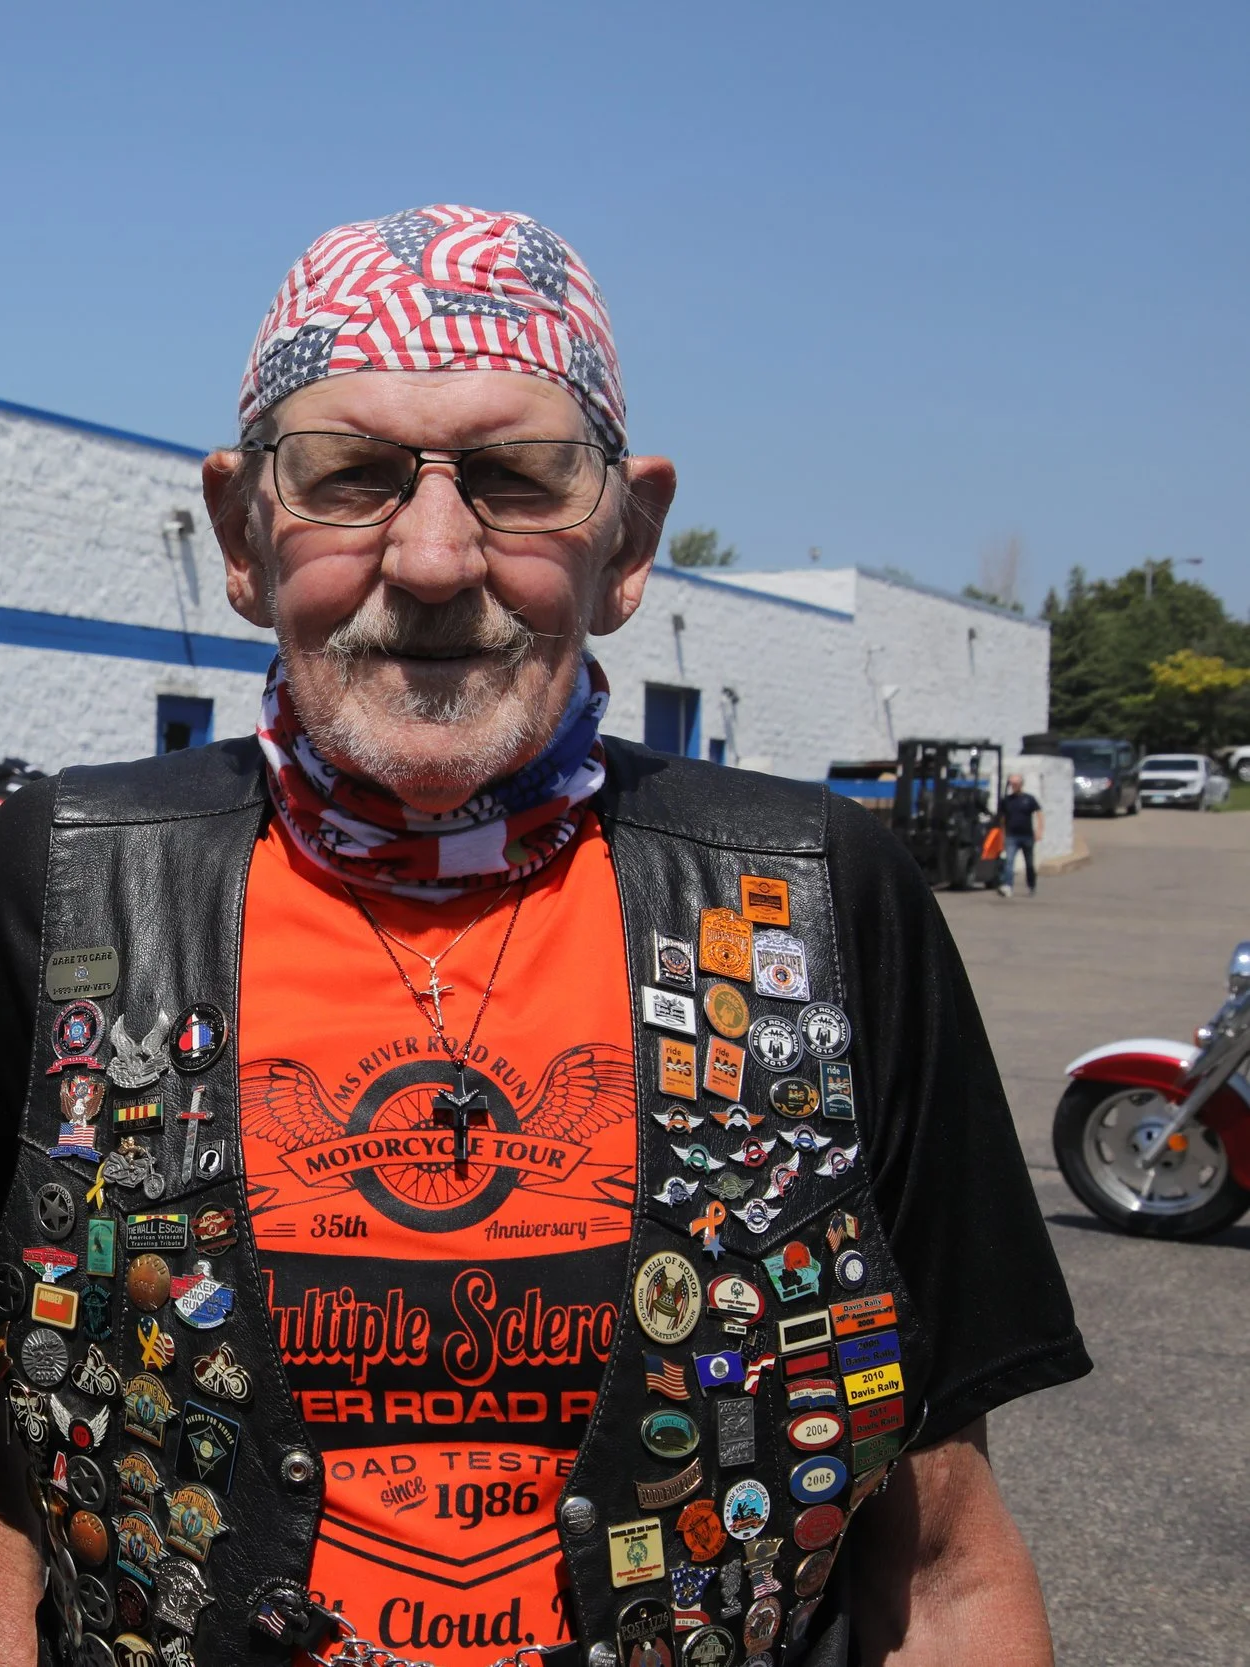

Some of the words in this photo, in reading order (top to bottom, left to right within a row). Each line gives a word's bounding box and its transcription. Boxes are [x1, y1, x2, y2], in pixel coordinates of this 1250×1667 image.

[52, 956, 76, 966] DARE
[77, 955, 88, 963] TO
[89, 951, 113, 962] CARE
[802, 1009, 817, 1033] RIVER
[818, 1007, 841, 1020] ROAD
[839, 1022, 847, 1041] RUN
[753, 1022, 767, 1046] RIVER
[768, 1020, 792, 1032] ROAD
[791, 1033, 799, 1053] RUN
[666, 1046, 682, 1056] ride
[715, 1047, 730, 1057] ride
[333, 1072, 362, 1104] MS
[357, 1036, 420, 1076] RIVER
[427, 1034, 489, 1064] ROAD
[490, 1056, 532, 1100] RUN
[827, 1066, 841, 1075] ride
[492, 1138, 567, 1169] TOUR
[55, 1186, 71, 1204] FLOOD
[136, 1222, 157, 1234] WALL
[158, 1222, 185, 1234] ESCORT
[310, 1213, 369, 1239] 35th
[484, 1218, 588, 1242] Anniversary
[187, 1278, 217, 1293] BIKER
[643, 1258, 664, 1279] BELL
[664, 1256, 678, 1265] OF
[678, 1260, 699, 1299] HONOR
[39, 1290, 64, 1305] AMBER
[182, 1298, 203, 1310] RUN
[638, 1287, 646, 1312] VOICE
[843, 1303, 863, 1312] Davis
[864, 1298, 882, 1308] Rally
[640, 1312, 649, 1322] OF
[679, 1309, 697, 1335] NATION
[261, 1269, 431, 1386] ultiple
[650, 1326, 681, 1340] GRATEFUL
[845, 1354, 871, 1367] Davis
[872, 1348, 897, 1360] Rally
[862, 1370, 884, 1383] 2010
[851, 1386, 876, 1399] Davis
[877, 1379, 900, 1393] Rally
[386, 1390, 548, 1425] ROAD
[869, 1406, 887, 1418] 2011
[185, 1414, 205, 1425] BIKERS
[206, 1415, 217, 1426] FOR
[856, 1421, 879, 1433] Davis
[880, 1415, 900, 1428] Rally
[805, 1424, 829, 1437] 2004
[807, 1472, 832, 1487] 2005
[380, 1475, 428, 1510] since
[726, 1491, 736, 1508] RIDE
[735, 1483, 747, 1492] FOR
[171, 1490, 208, 1508] LIGHTNING
[206, 1502, 221, 1530] RUN
[434, 1480, 540, 1530] 1986
[117, 1515, 151, 1533] LIGHTNING
[621, 1620, 646, 1634] POST
[648, 1611, 669, 1628] 1776
